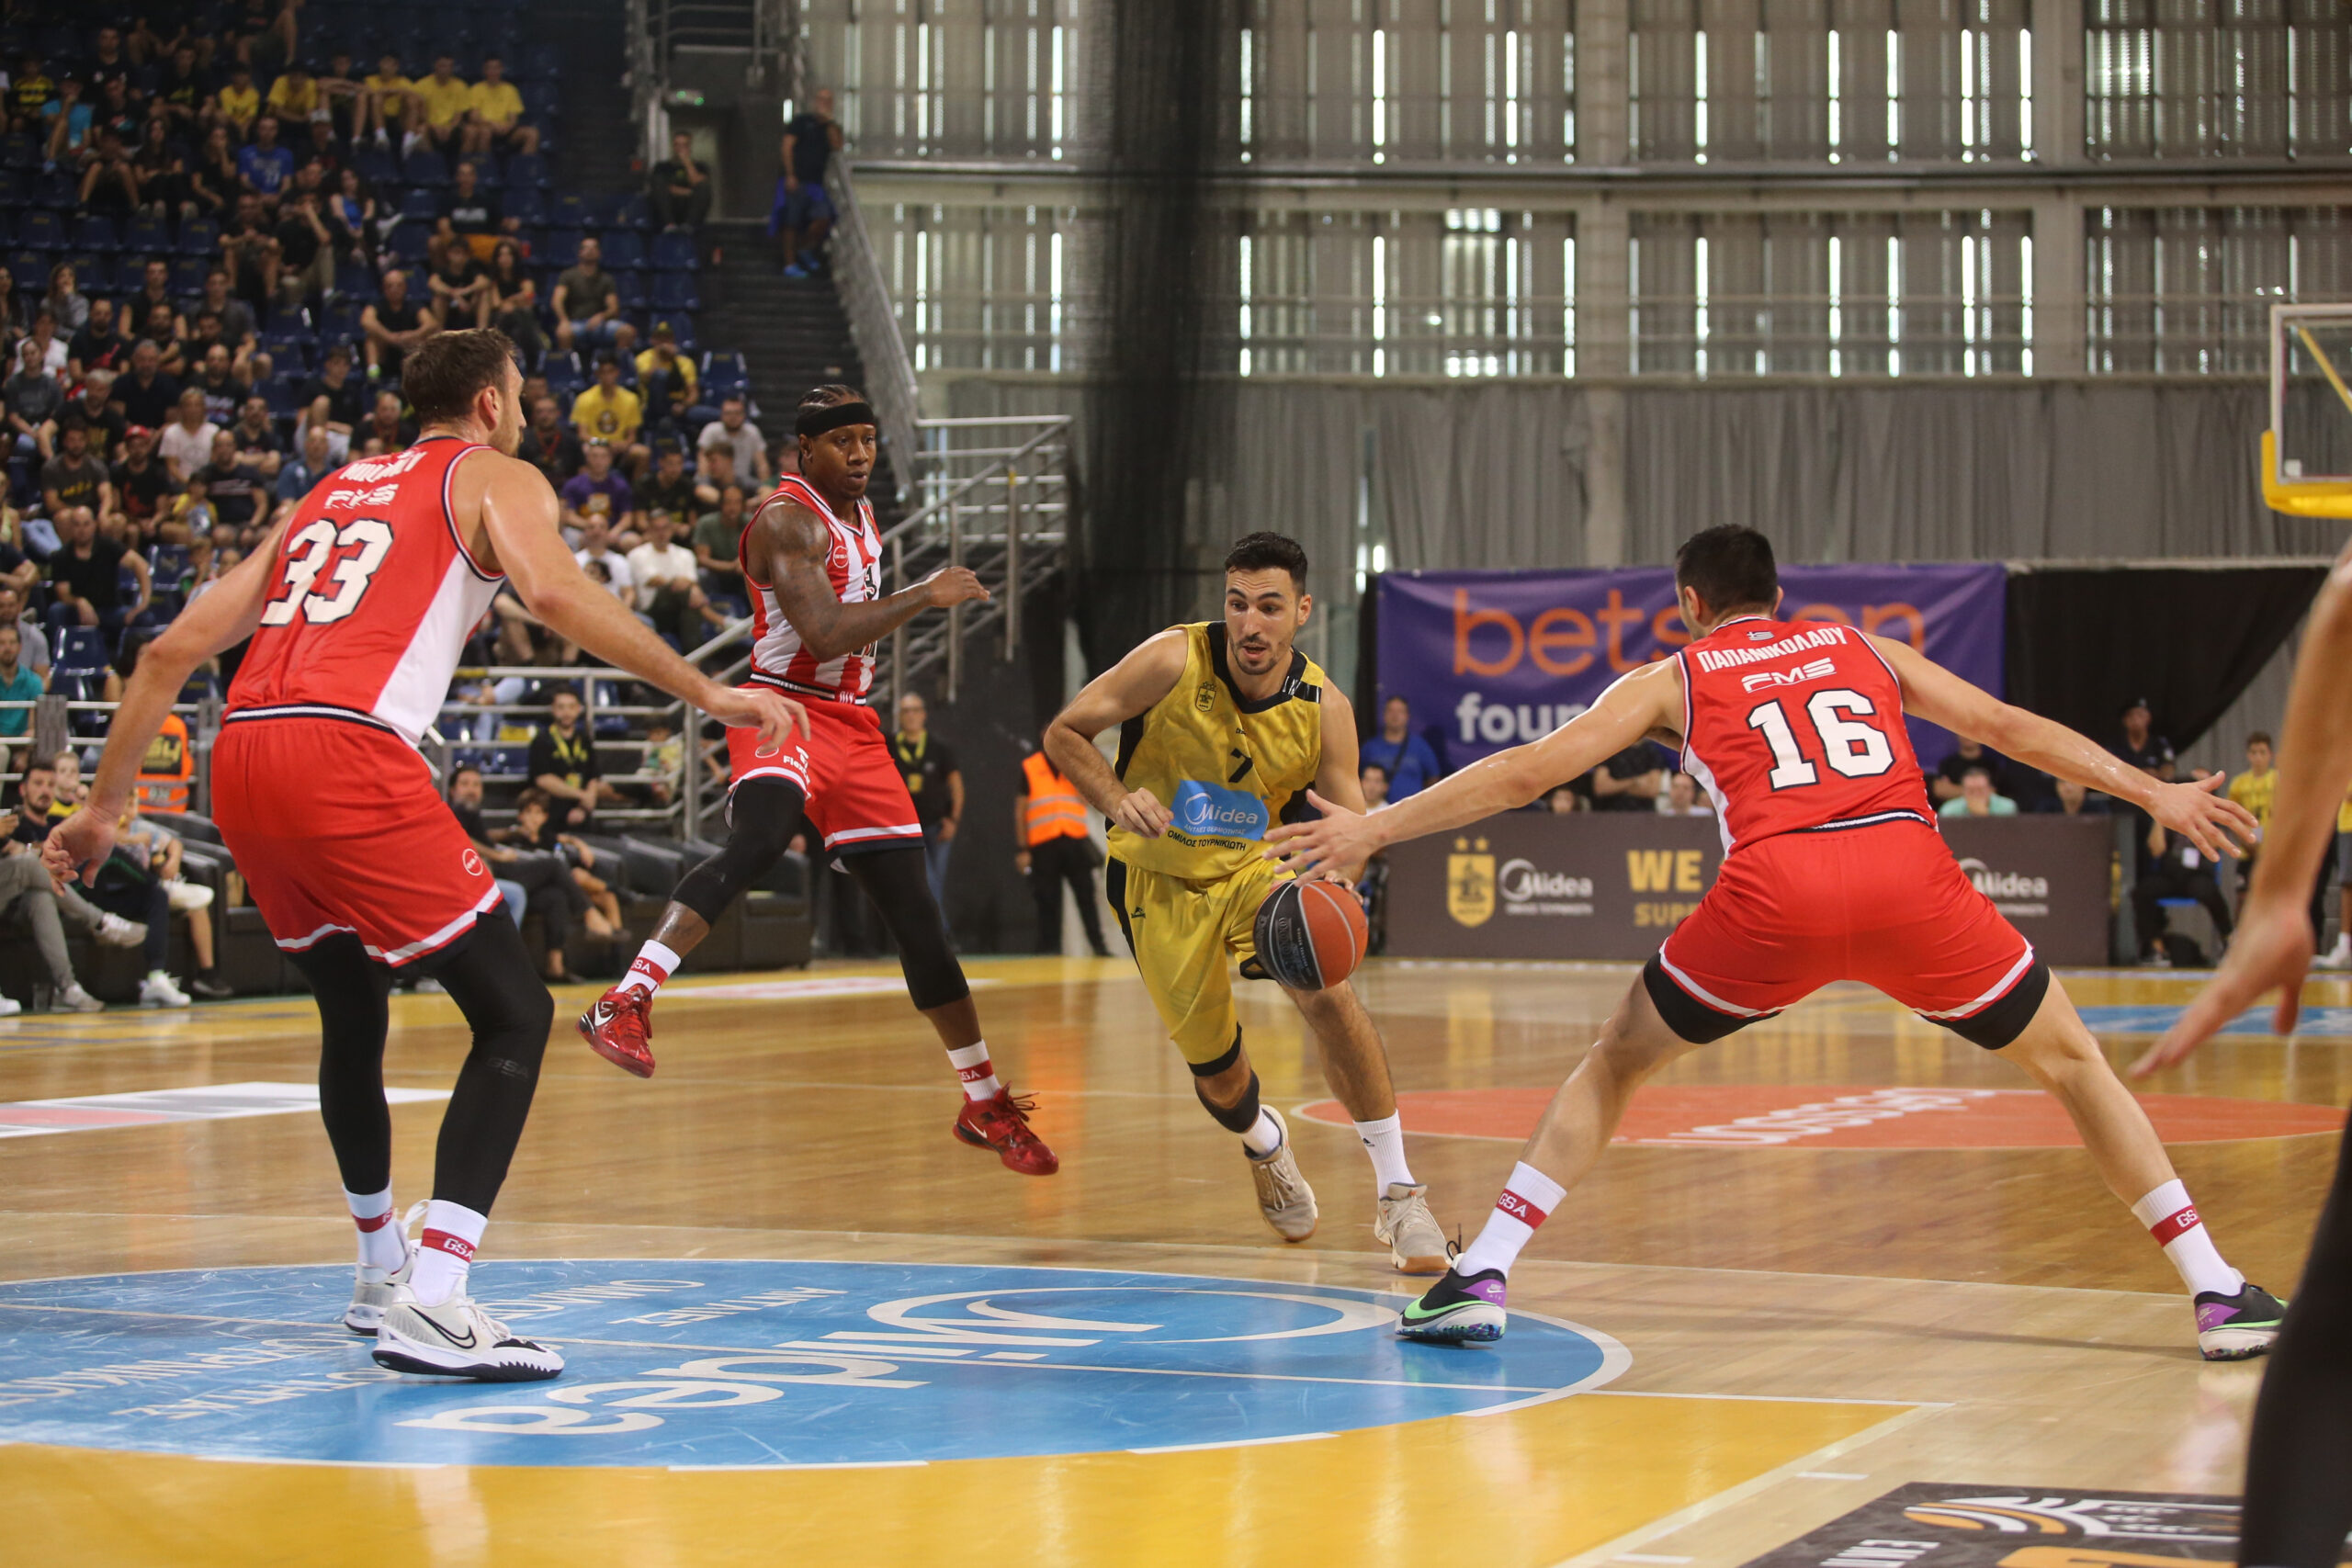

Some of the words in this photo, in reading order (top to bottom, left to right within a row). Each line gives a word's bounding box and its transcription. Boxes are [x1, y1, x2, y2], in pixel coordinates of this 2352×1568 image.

[260, 518, 393, 626] 33
[1697, 627, 1848, 673] ΠΑΠΑΝΙΚΟΛΑΟΥ
[1741, 657, 1837, 694] FMS
[1746, 688, 1896, 792] 16
[1228, 748, 1254, 784] 7
[1184, 792, 1259, 825] Midea
[1167, 829, 1197, 848] ΟΜΙΛΟΣ
[1198, 838, 1247, 852] ΤΟΥΡΝΙΚΙΩΤΗ
[1504, 862, 1593, 901] Midea
[1626, 849, 1704, 893] WE
[1498, 1192, 1527, 1218] GSA
[443, 1237, 474, 1260] GSA
[393, 1288, 1402, 1435] Midea
